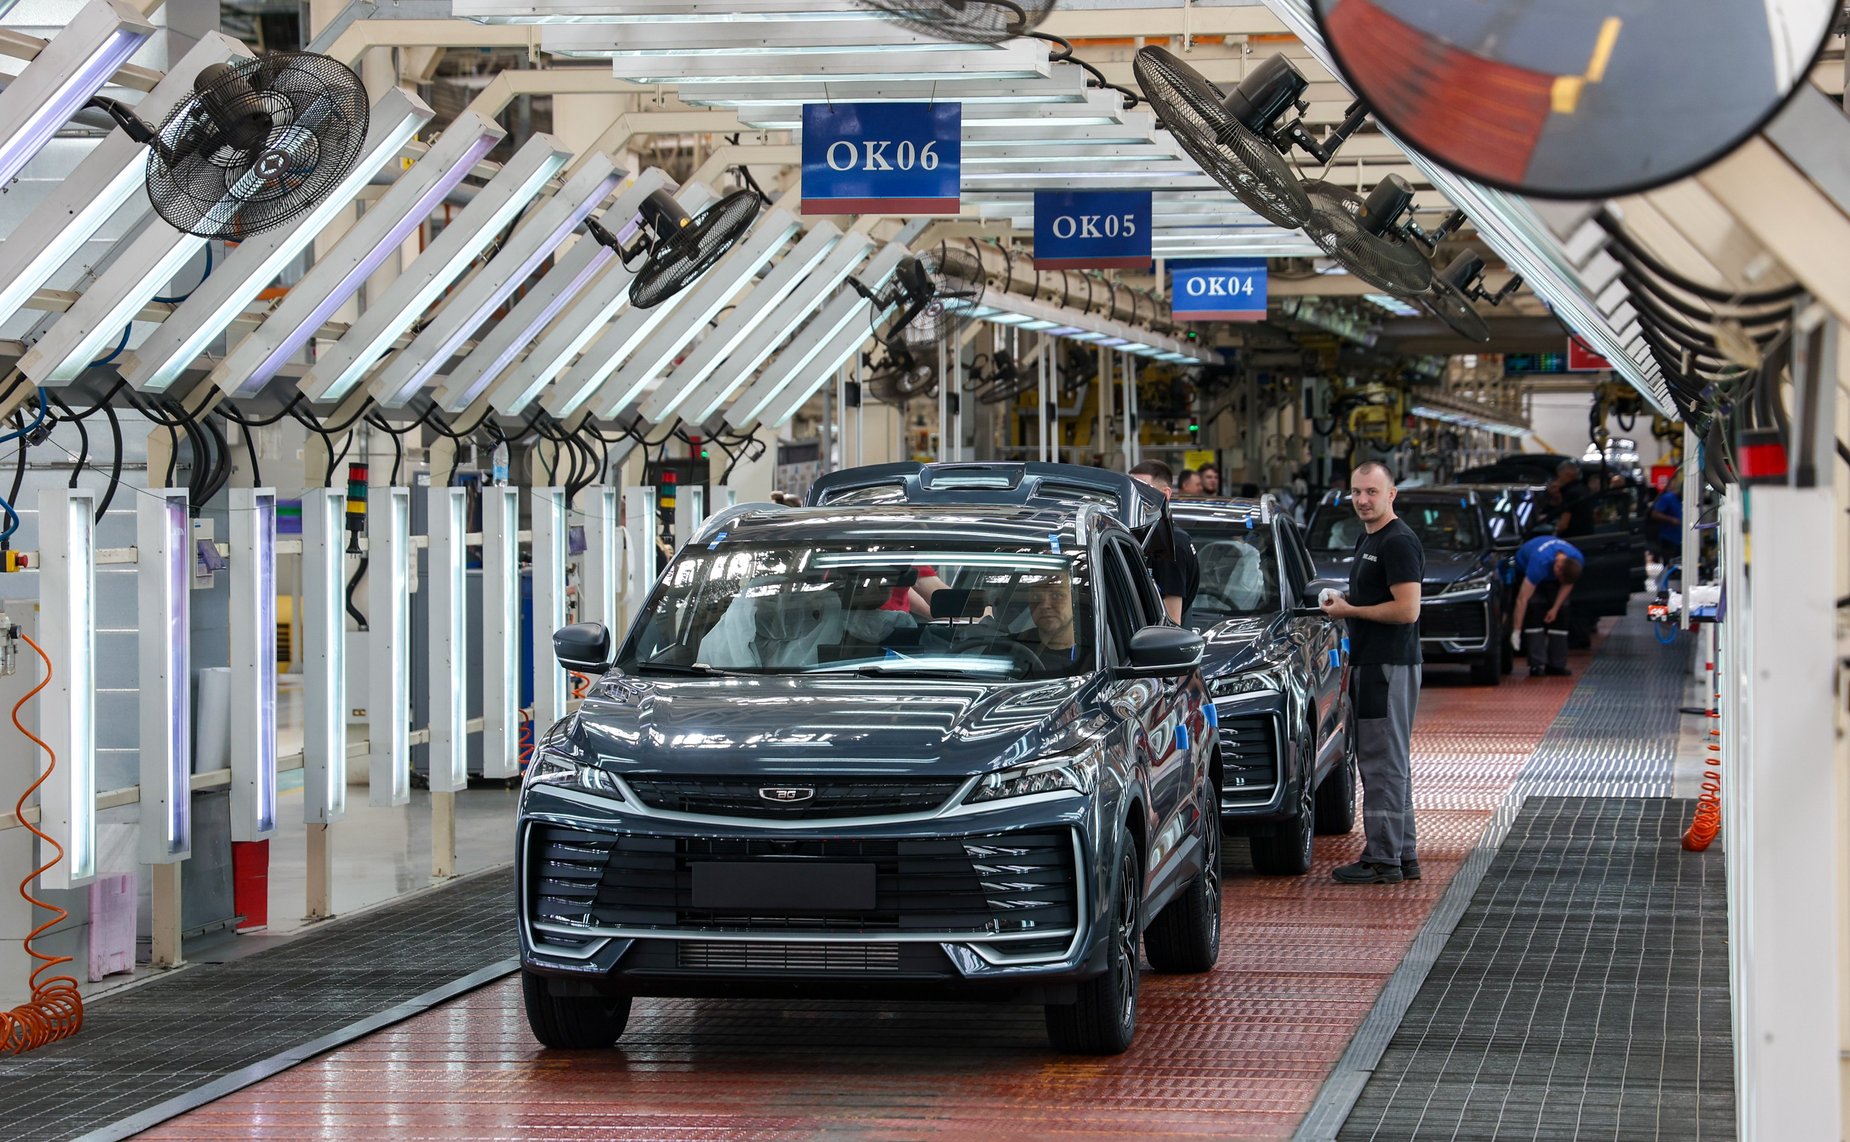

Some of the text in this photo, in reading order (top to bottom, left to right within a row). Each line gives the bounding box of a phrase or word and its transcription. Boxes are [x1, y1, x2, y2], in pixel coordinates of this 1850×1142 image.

[826, 140, 940, 171] OK06
[1052, 214, 1136, 238] OK05
[1186, 276, 1254, 296] OK04
